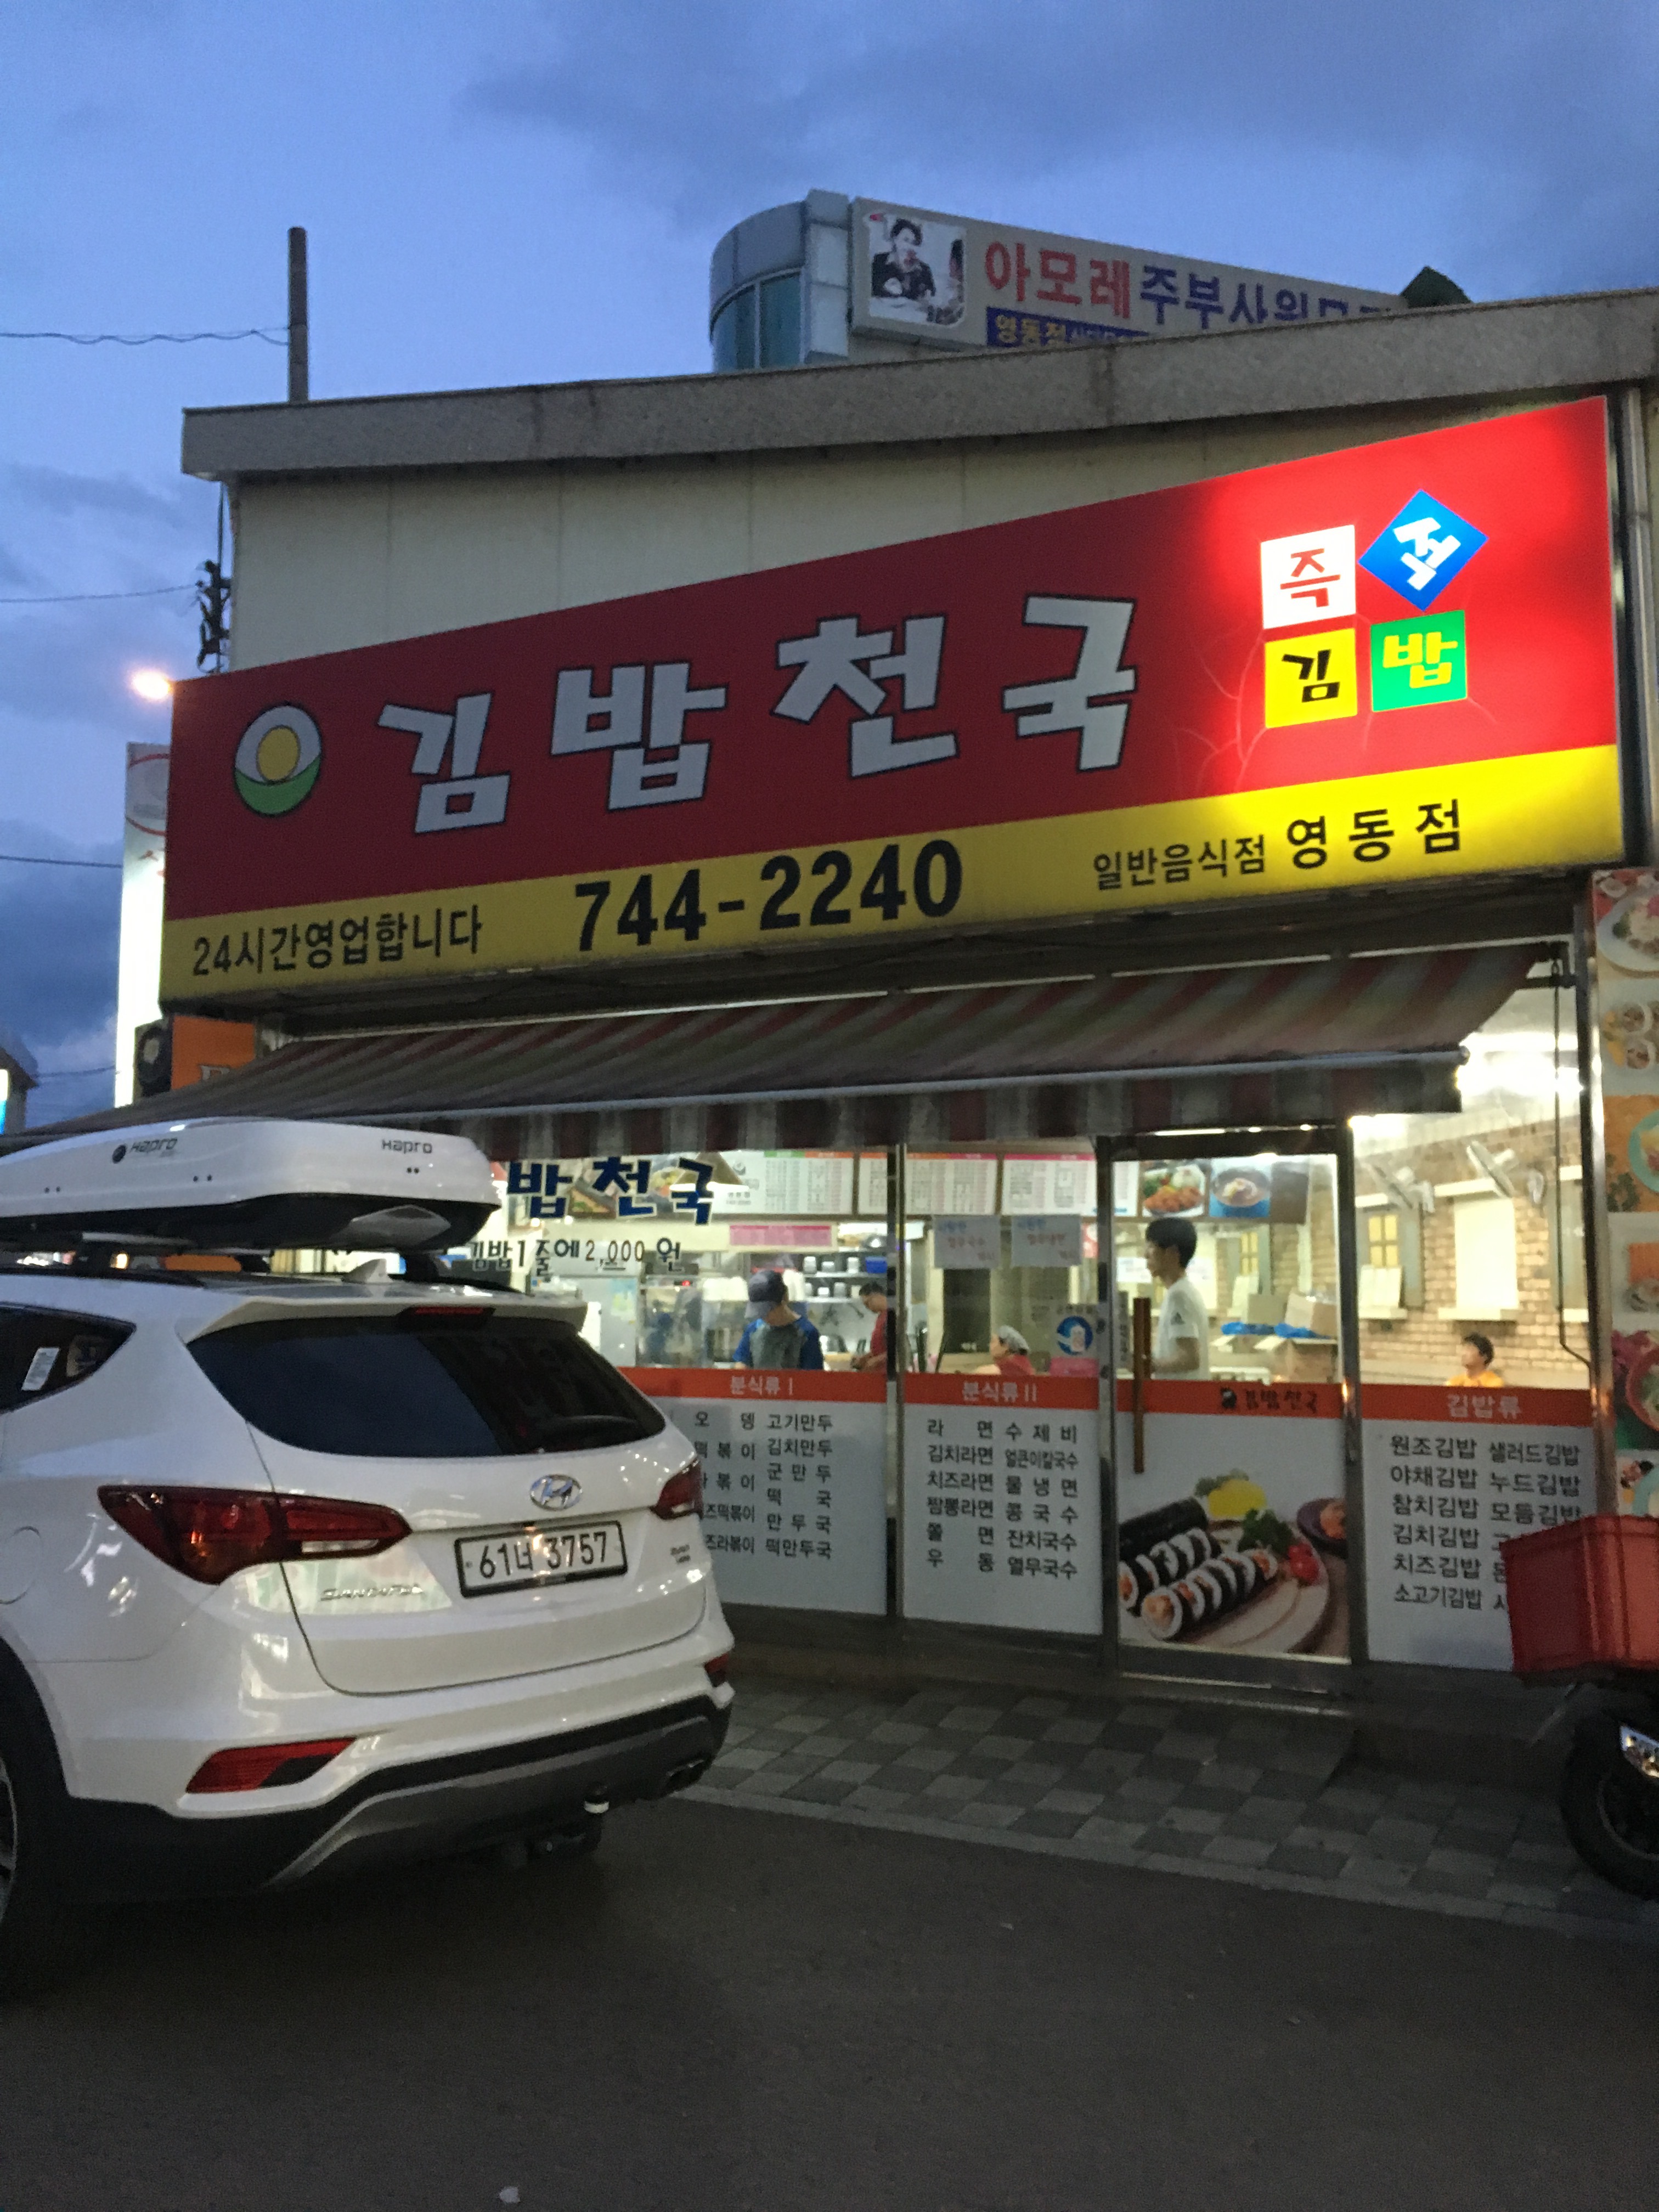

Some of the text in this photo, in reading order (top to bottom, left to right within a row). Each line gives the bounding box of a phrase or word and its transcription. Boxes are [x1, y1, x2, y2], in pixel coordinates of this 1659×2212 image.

[985, 242, 1131, 319] 아모레
[377, 593, 1136, 834] 김밥천국
[574, 840, 962, 951] 744-2240
[1093, 834, 1266, 891] 일반음식점
[1286, 799, 1461, 870] 영동점
[731, 1375, 781, 1395] 분식류
[962, 1382, 1018, 1402] 분식류
[1448, 1394, 1521, 1419] 김밥류
[769, 1414, 833, 1431] 고기만두
[768, 1439, 833, 1457] 김치만두
[928, 1443, 994, 1465] 김치라면
[1391, 1435, 1477, 1459] 원조김밥
[1489, 1442, 1580, 1466] 샐러드김밥
[927, 1469, 994, 1492] 치즈라면
[1391, 1465, 1477, 1489] 야채김밥
[1489, 1472, 1581, 1497] 누드김밥
[927, 1497, 994, 1519] 짬뽕라면
[1392, 1493, 1479, 1519] 참치김밥
[766, 1538, 831, 1559] 떡만두국
[1007, 1529, 1077, 1551] 잔치국수
[1393, 1524, 1479, 1549] 김치김밥
[480, 1531, 607, 1579] 61너 3757
[1393, 1553, 1481, 1579] 치즈김밥
[1007, 1556, 1077, 1579] 열무국수
[1394, 1583, 1482, 1610] 소고기김밥
